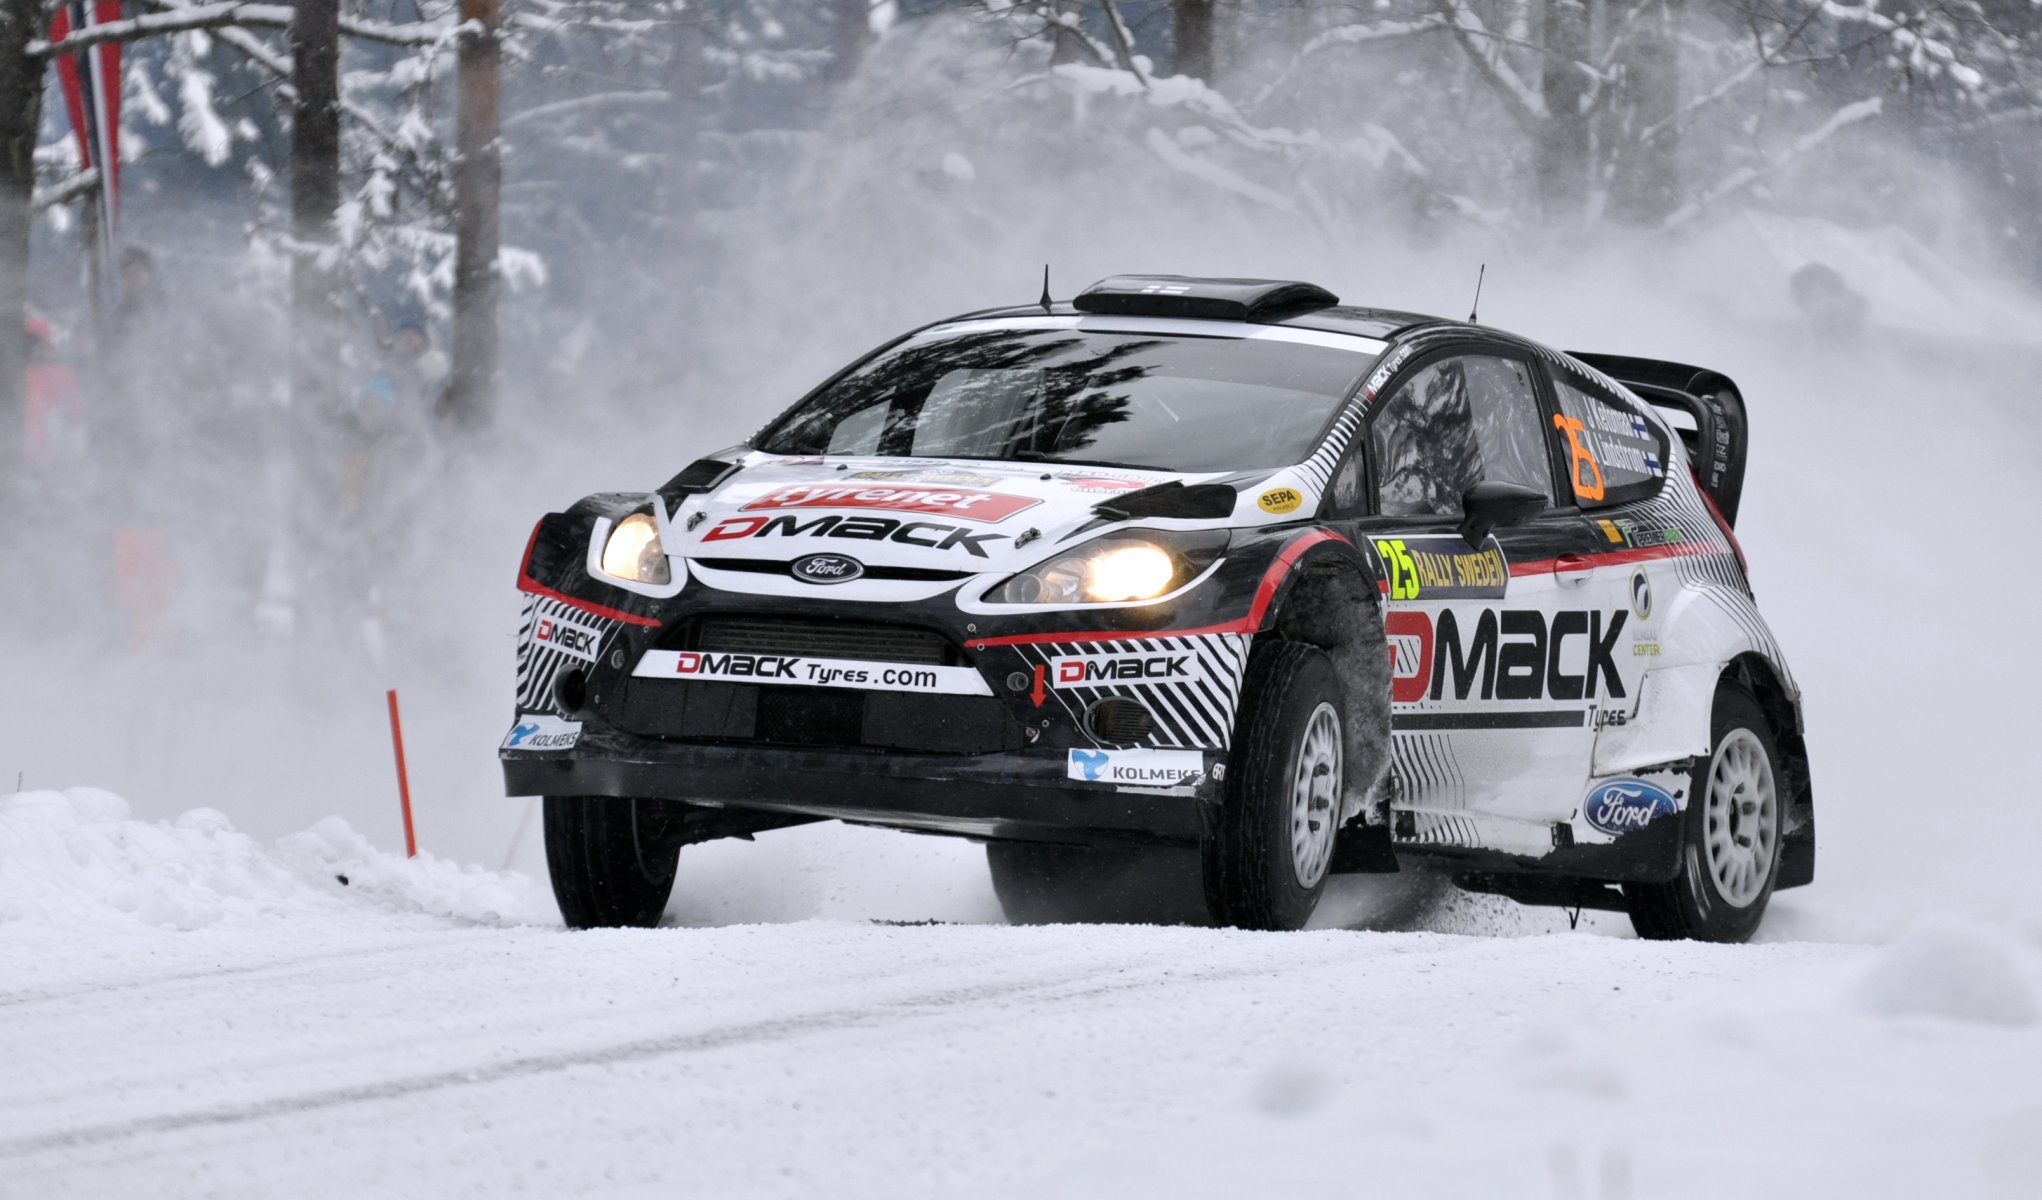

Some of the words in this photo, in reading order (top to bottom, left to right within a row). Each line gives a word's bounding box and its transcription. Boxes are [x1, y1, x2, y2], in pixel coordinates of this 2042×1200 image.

[1553, 412, 1605, 502] 25
[771, 485, 992, 509] tyrenet
[1262, 490, 1297, 506] SEPA
[701, 515, 1012, 559] DMACK
[806, 558, 847, 575] Ford
[1376, 540, 1420, 600] 25
[1410, 549, 1454, 587] RALLY
[1453, 548, 1505, 587] SWEDEN
[537, 620, 596, 655] DMACK
[1632, 643, 1662, 656] CENTER
[676, 652, 800, 679] DMACK
[1059, 655, 1189, 683] DMACK
[1386, 608, 1629, 702] DMACK
[529, 730, 578, 747] KOLMEKS
[1597, 787, 1659, 828] Ford
